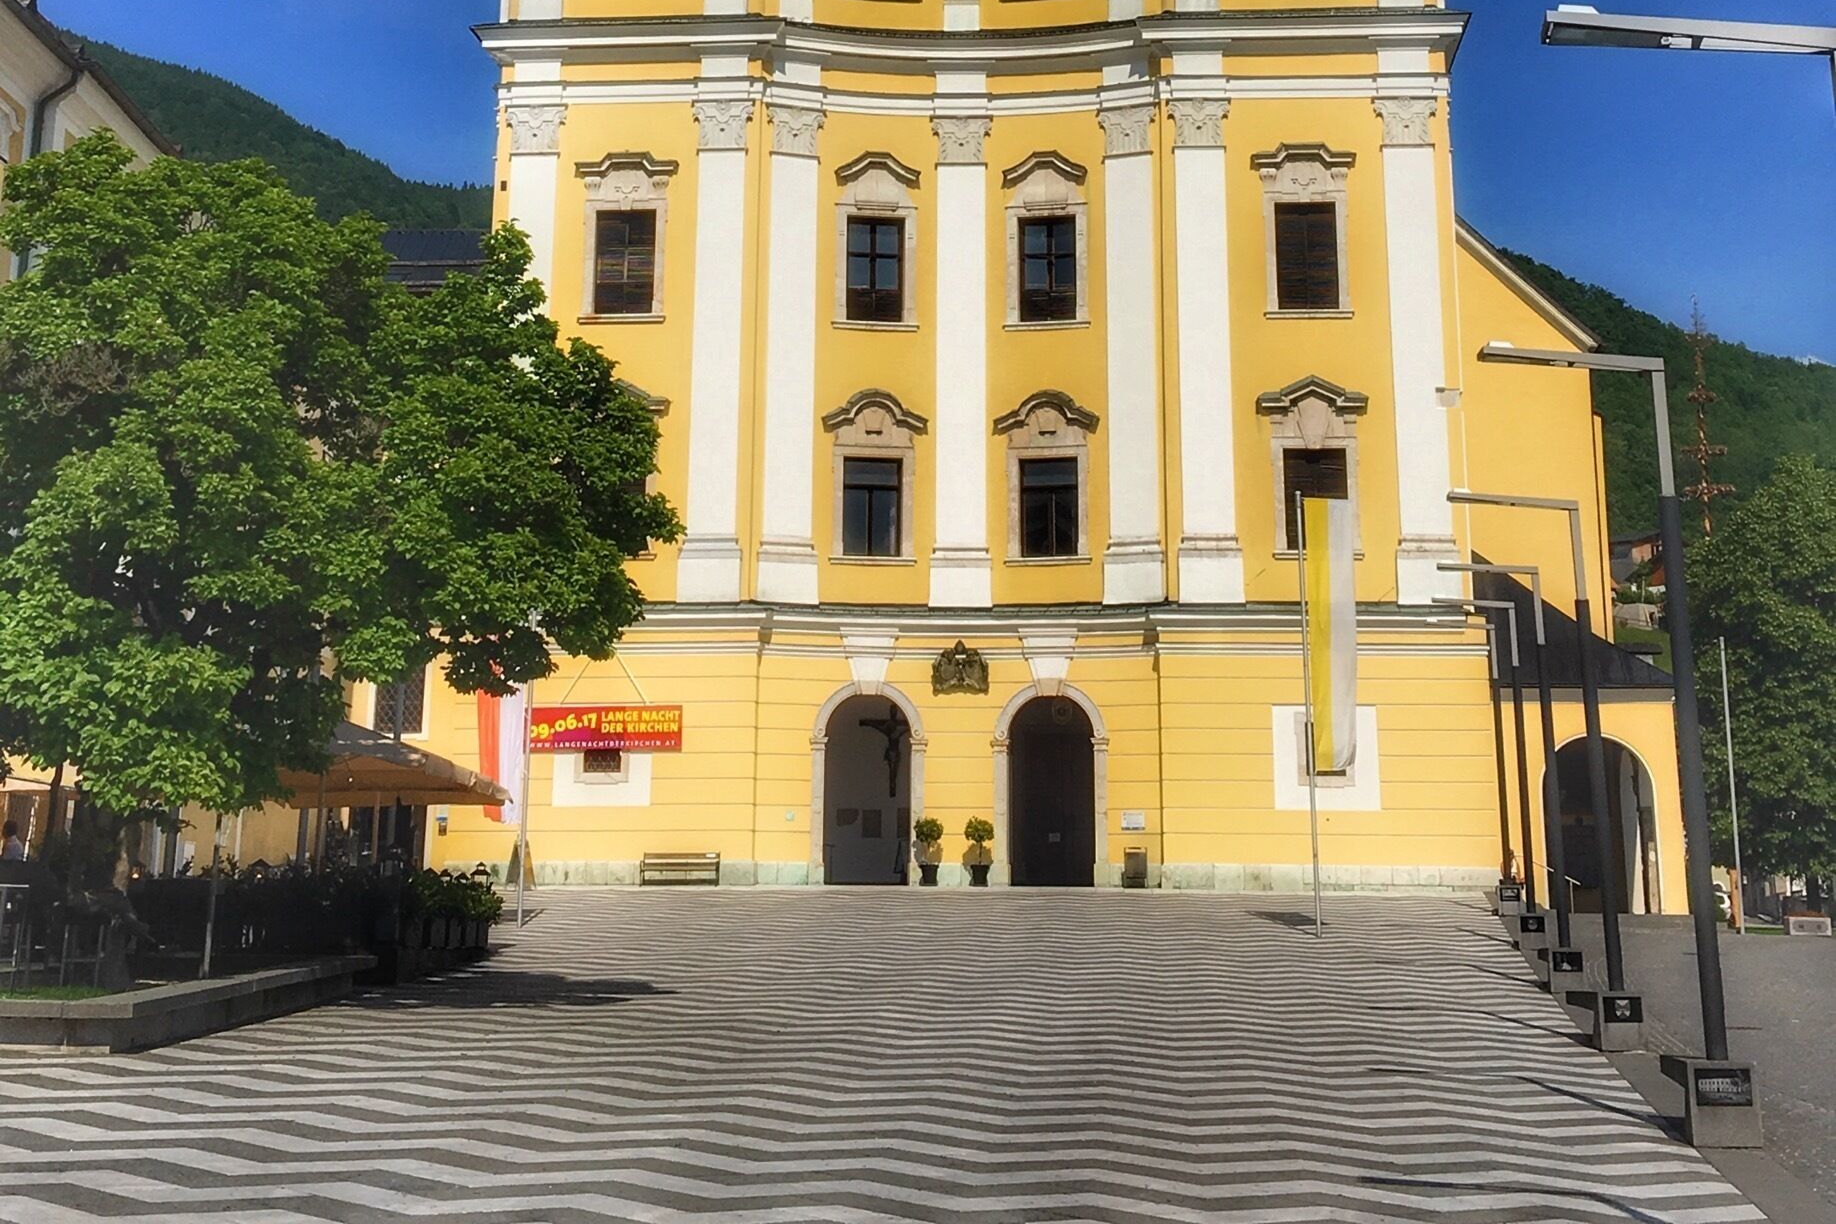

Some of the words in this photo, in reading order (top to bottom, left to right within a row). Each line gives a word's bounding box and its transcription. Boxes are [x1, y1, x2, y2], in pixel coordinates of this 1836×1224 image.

[601, 711, 639, 722] LANGE
[641, 710, 680, 721] NACHT
[530, 713, 598, 739] 09.06.17
[601, 722, 624, 733] DER
[627, 722, 679, 733] KIRCHEN
